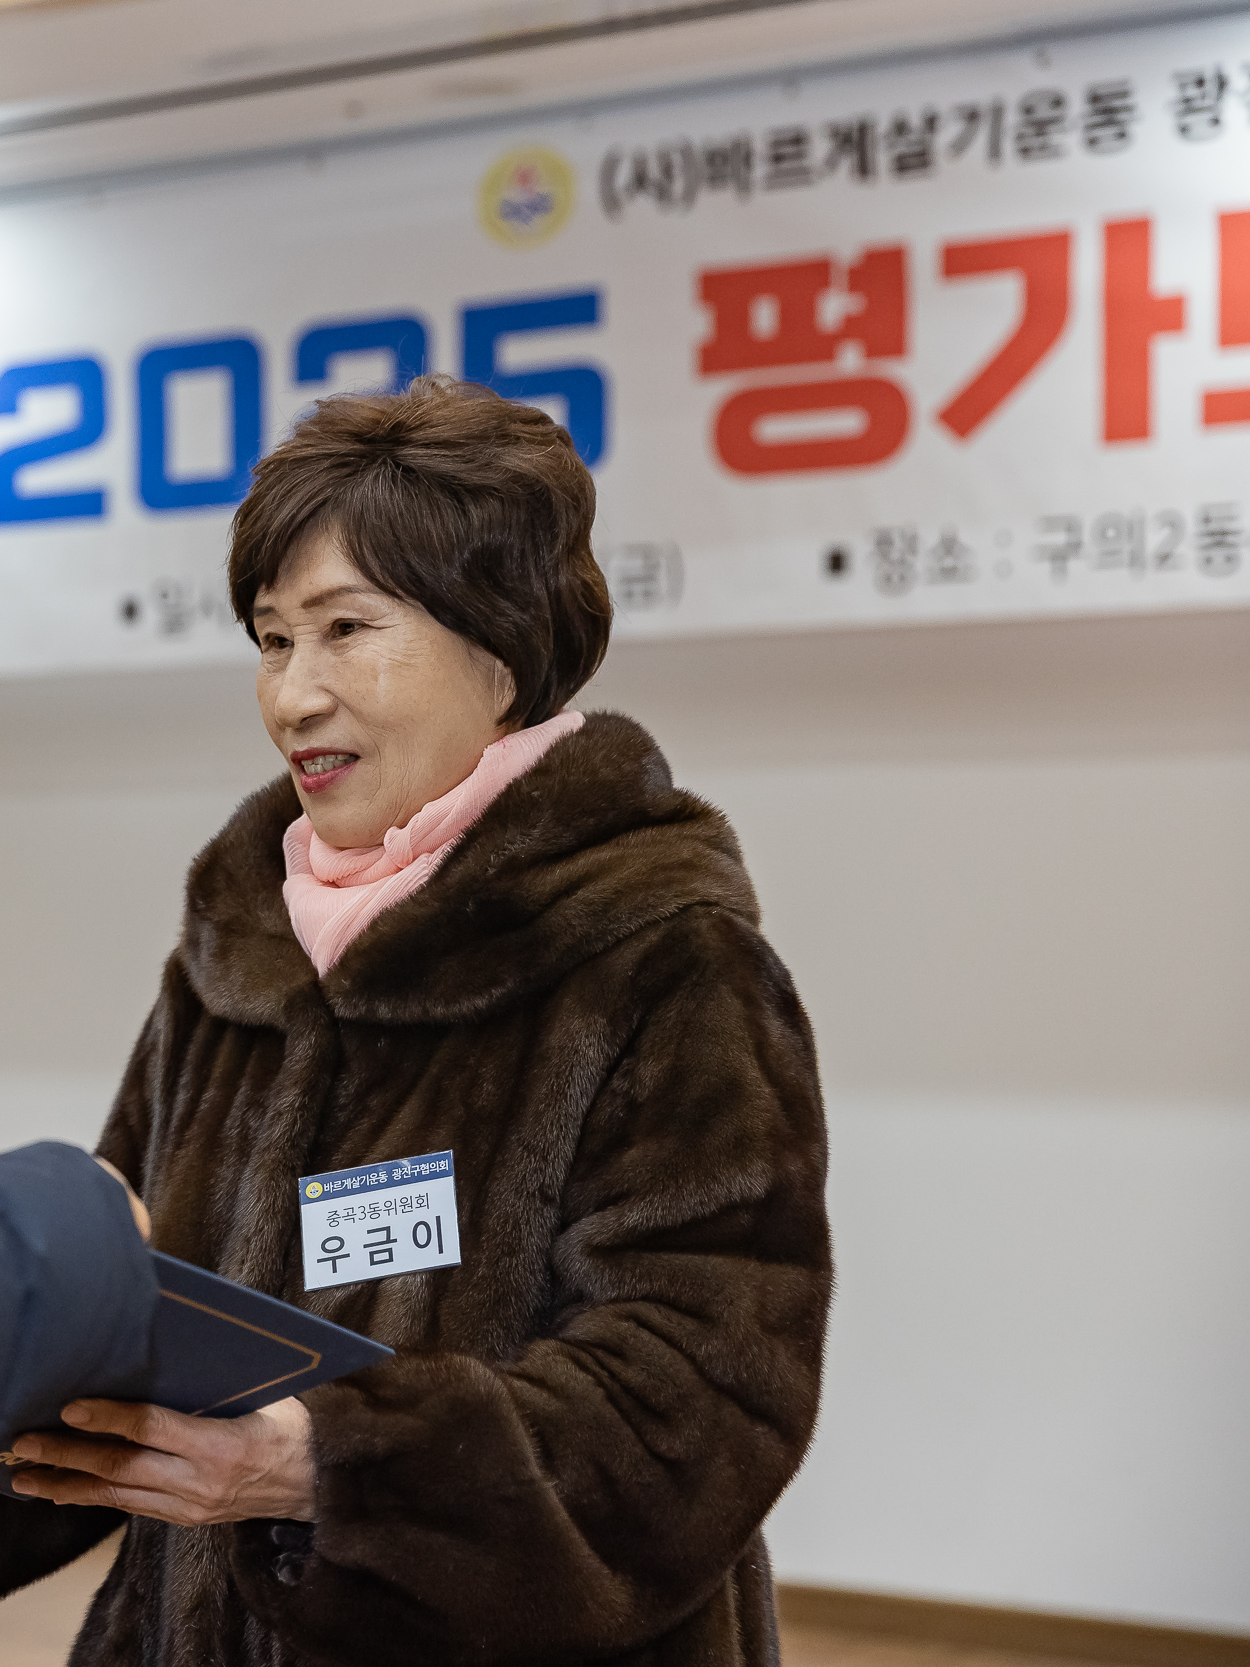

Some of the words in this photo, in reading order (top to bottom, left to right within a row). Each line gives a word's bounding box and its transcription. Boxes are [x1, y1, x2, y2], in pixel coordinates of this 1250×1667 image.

[1168, 62, 1250, 143] 광
[324, 1171, 388, 1193] 바르게살기운동
[391, 1159, 449, 1180] 광진구협의회
[326, 1192, 430, 1228] 중곡3동위원회
